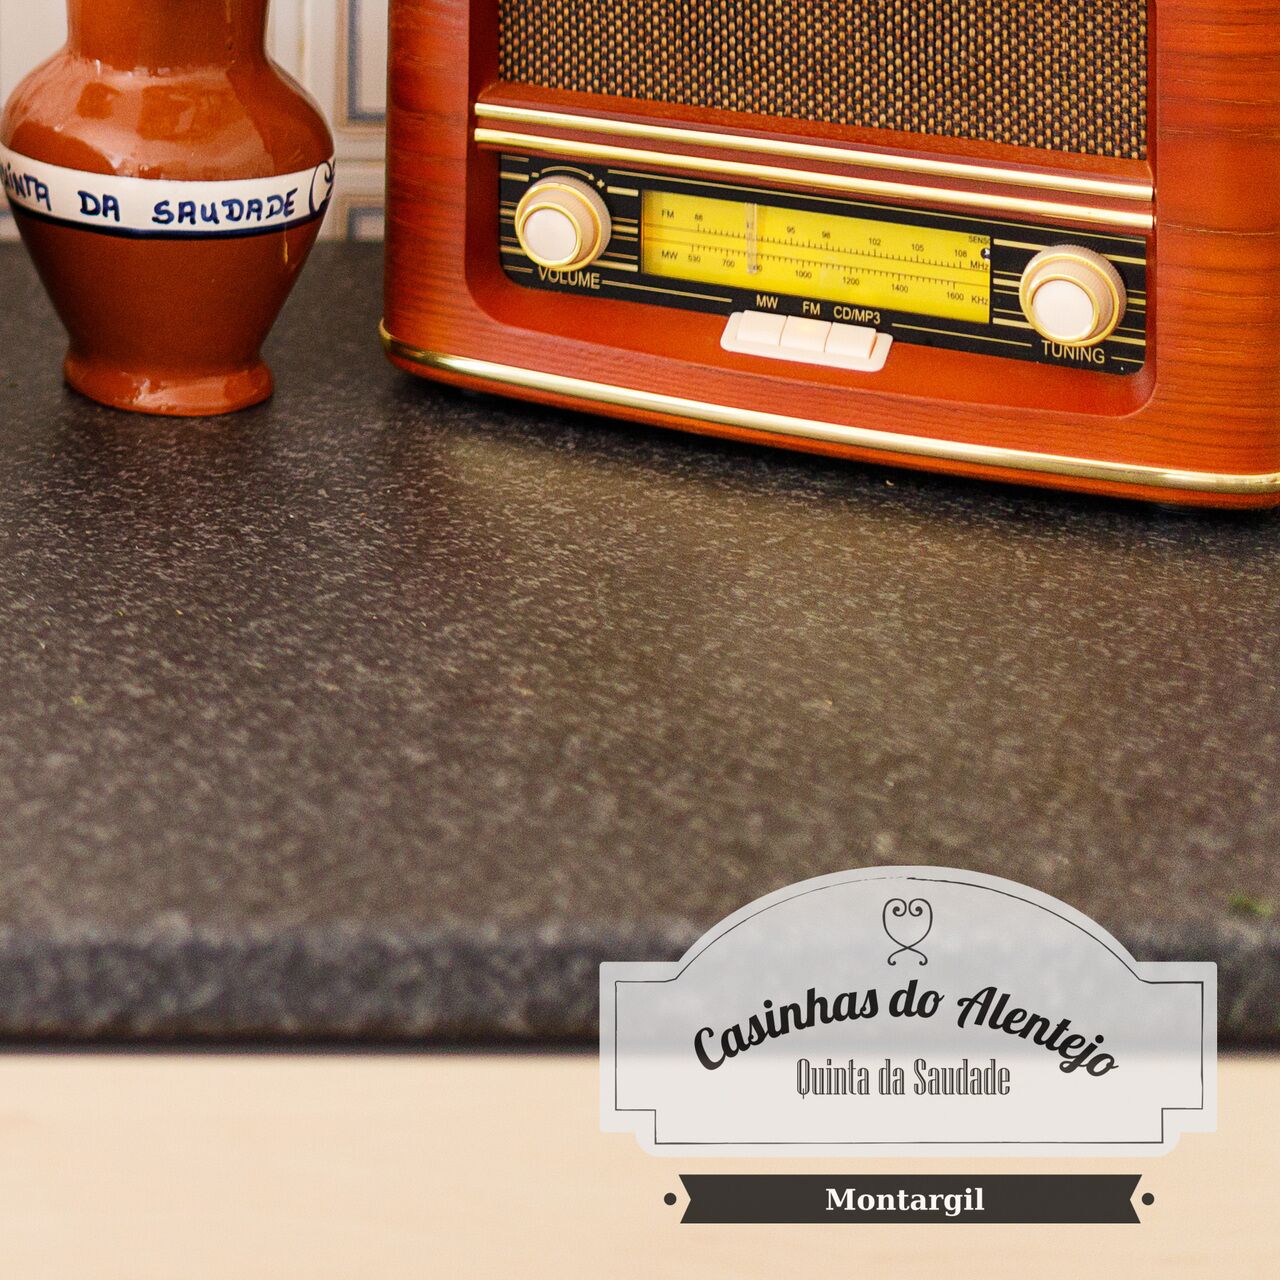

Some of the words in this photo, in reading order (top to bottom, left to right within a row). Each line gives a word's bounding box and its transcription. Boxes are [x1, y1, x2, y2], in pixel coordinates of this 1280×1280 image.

[77, 190, 120, 222] DA
[152, 187, 299, 225] SAUDADE
[661, 209, 675, 219] FM
[868, 237, 882, 247] 102
[911, 243, 925, 253] 105
[538, 265, 600, 289] VOLUME
[661, 250, 679, 261] MW
[795, 269, 813, 280] 1000
[842, 276, 860, 287] 1200
[891, 283, 909, 294] 1400
[946, 291, 965, 302] 1600
[971, 295, 989, 306] KHz
[970, 260, 989, 272] MHz
[756, 294, 779, 310] MW
[802, 301, 821, 316] FM
[833, 305, 881, 325] CD/MP3
[1041, 340, 1105, 364] TUNING
